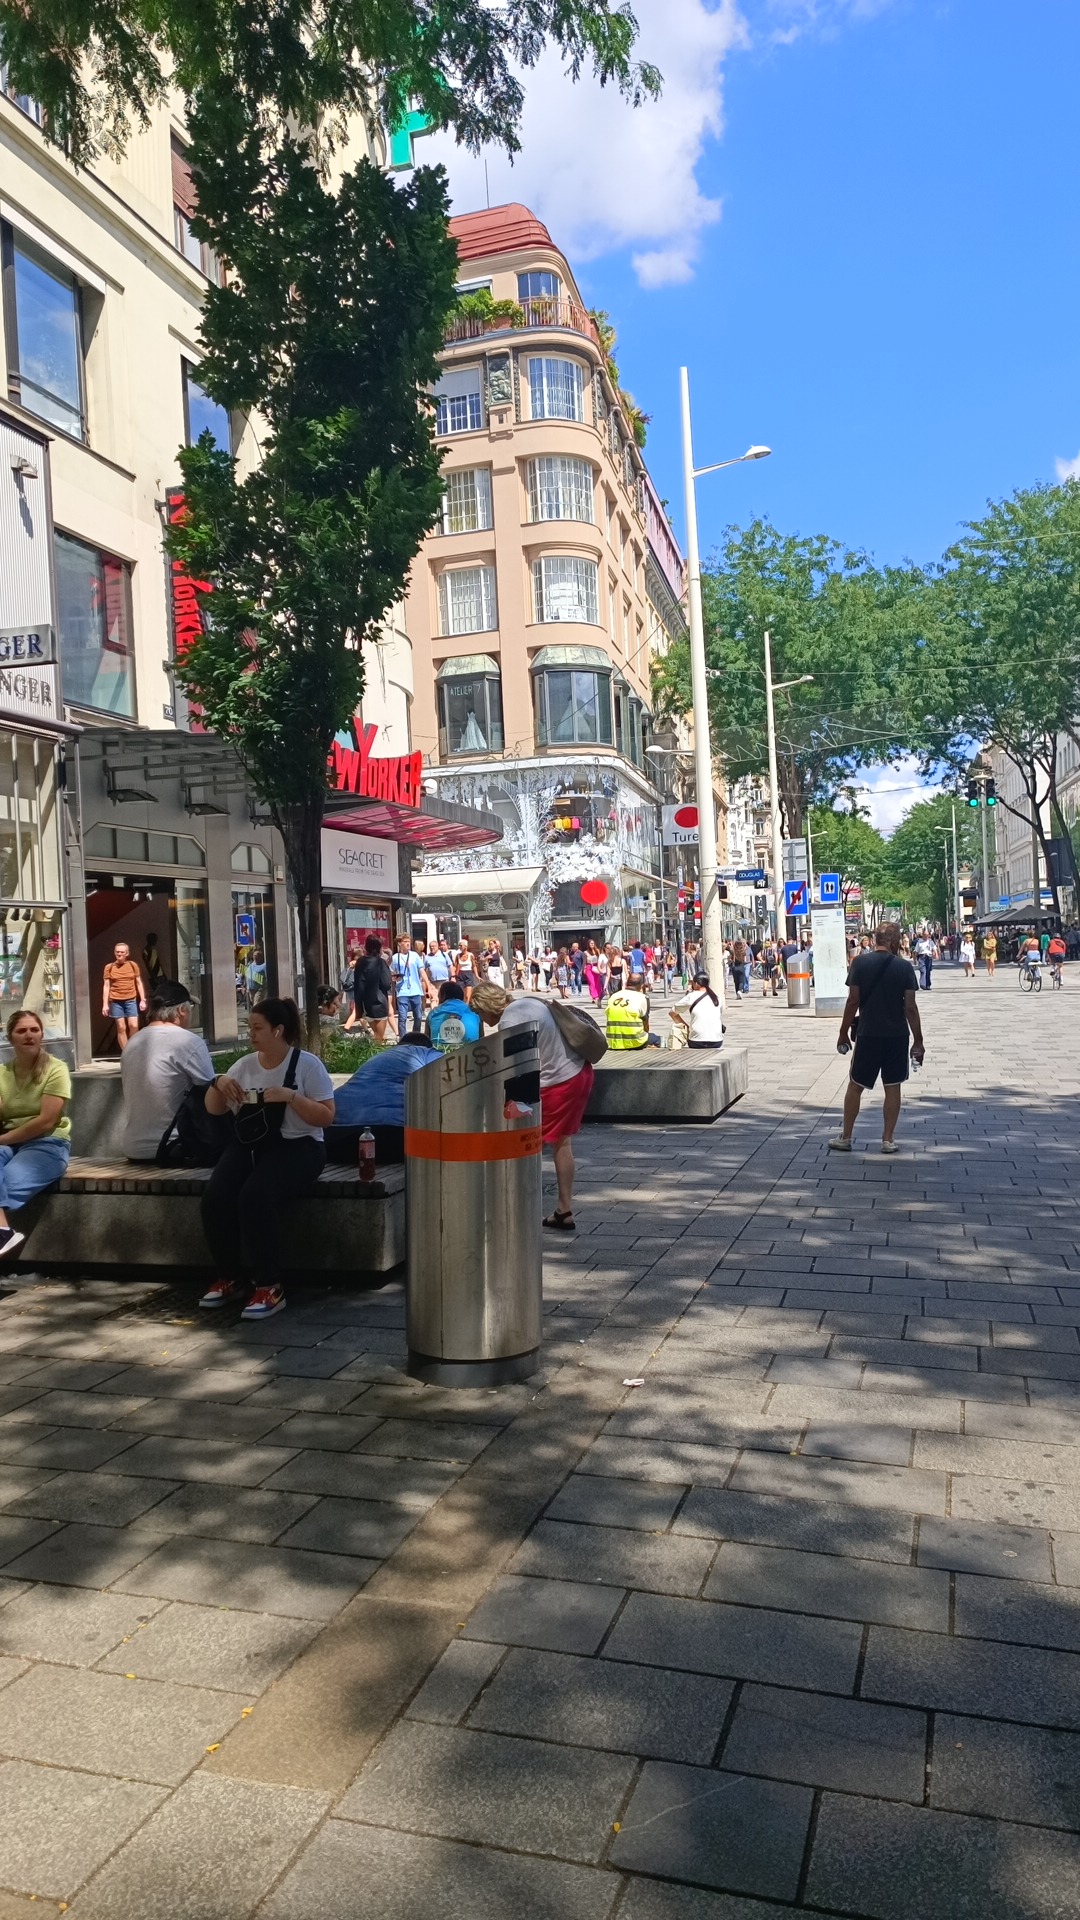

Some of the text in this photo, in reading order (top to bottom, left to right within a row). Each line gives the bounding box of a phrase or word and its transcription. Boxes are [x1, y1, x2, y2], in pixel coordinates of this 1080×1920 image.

[353, 715, 422, 809] YORKER
[338, 848, 386, 869] SEACRET
[579, 906, 611, 919] Turek
